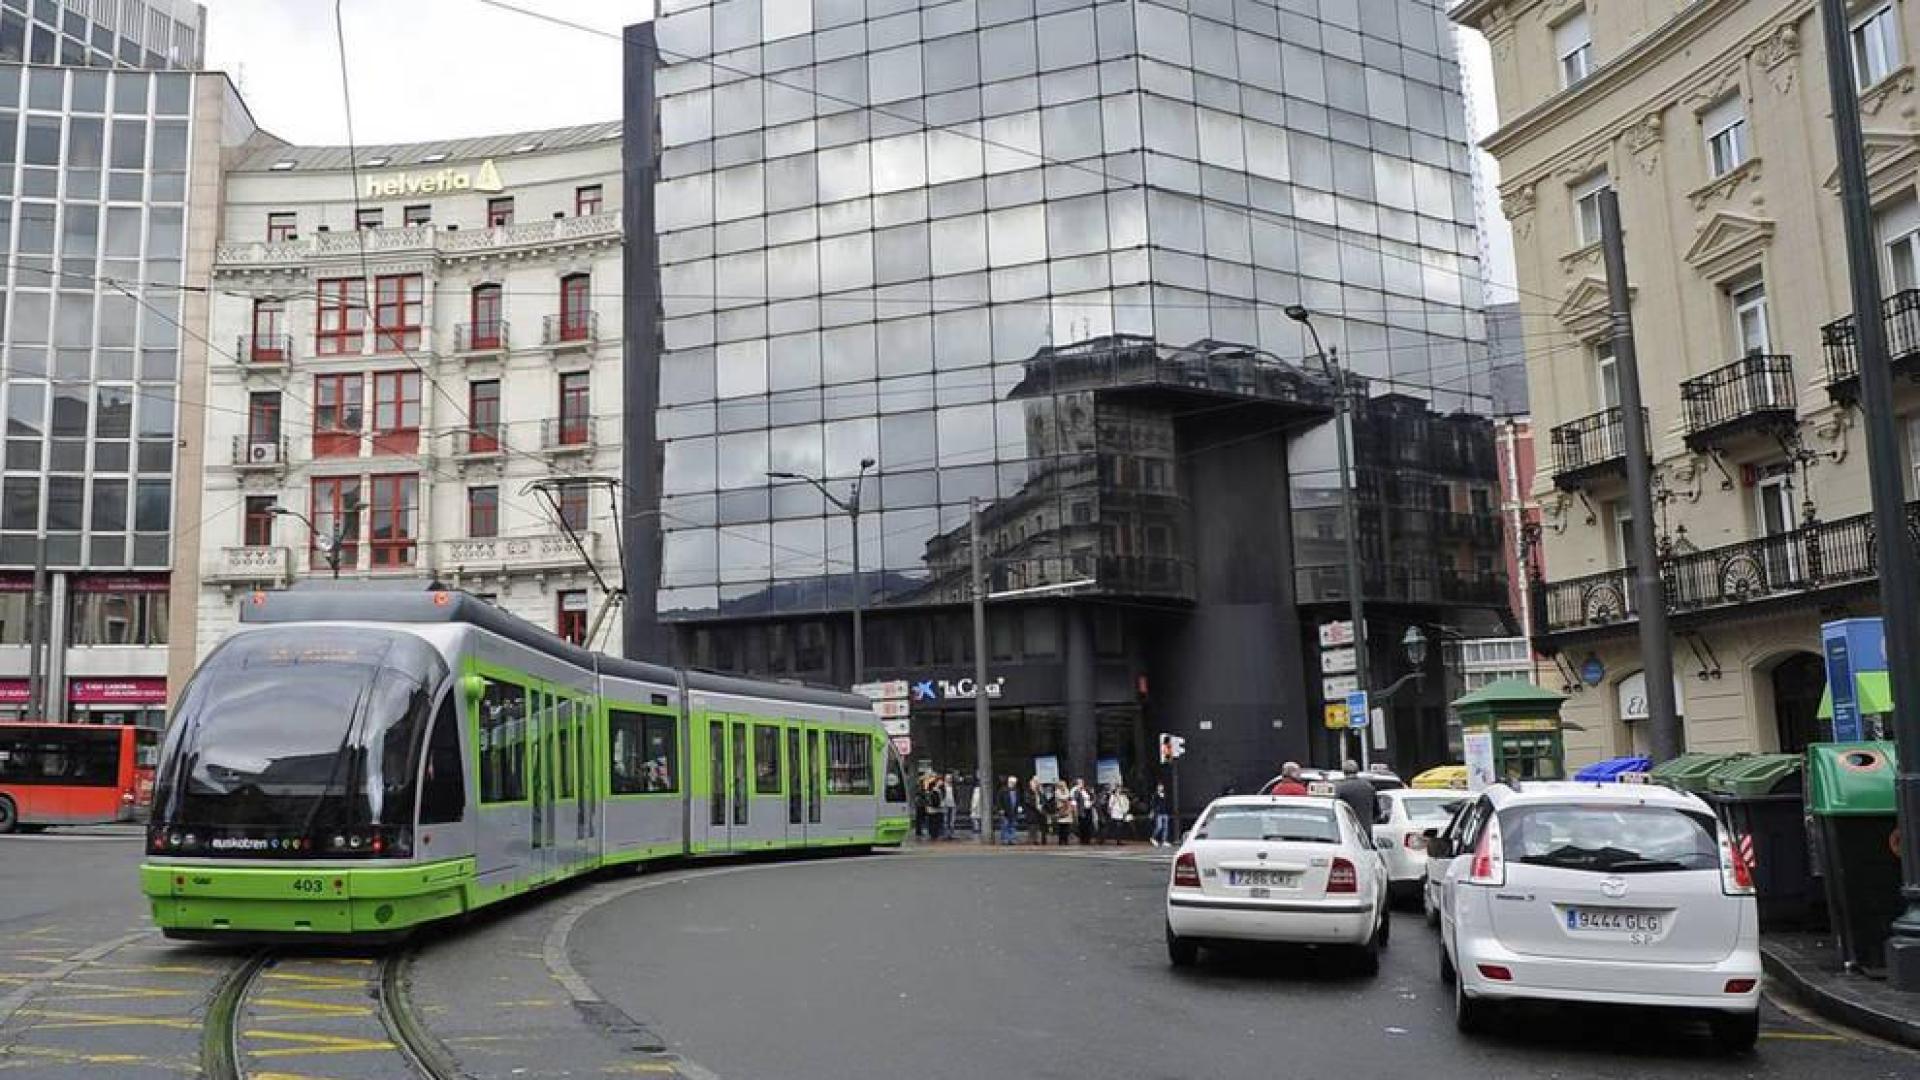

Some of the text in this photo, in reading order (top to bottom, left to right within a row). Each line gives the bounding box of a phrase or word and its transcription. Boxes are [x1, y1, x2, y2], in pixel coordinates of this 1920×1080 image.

[366, 168, 470, 195] helvetia
[212, 837, 268, 850] euskotren
[293, 879, 323, 893] 403
[1579, 912, 1658, 932] 9444 GLG
